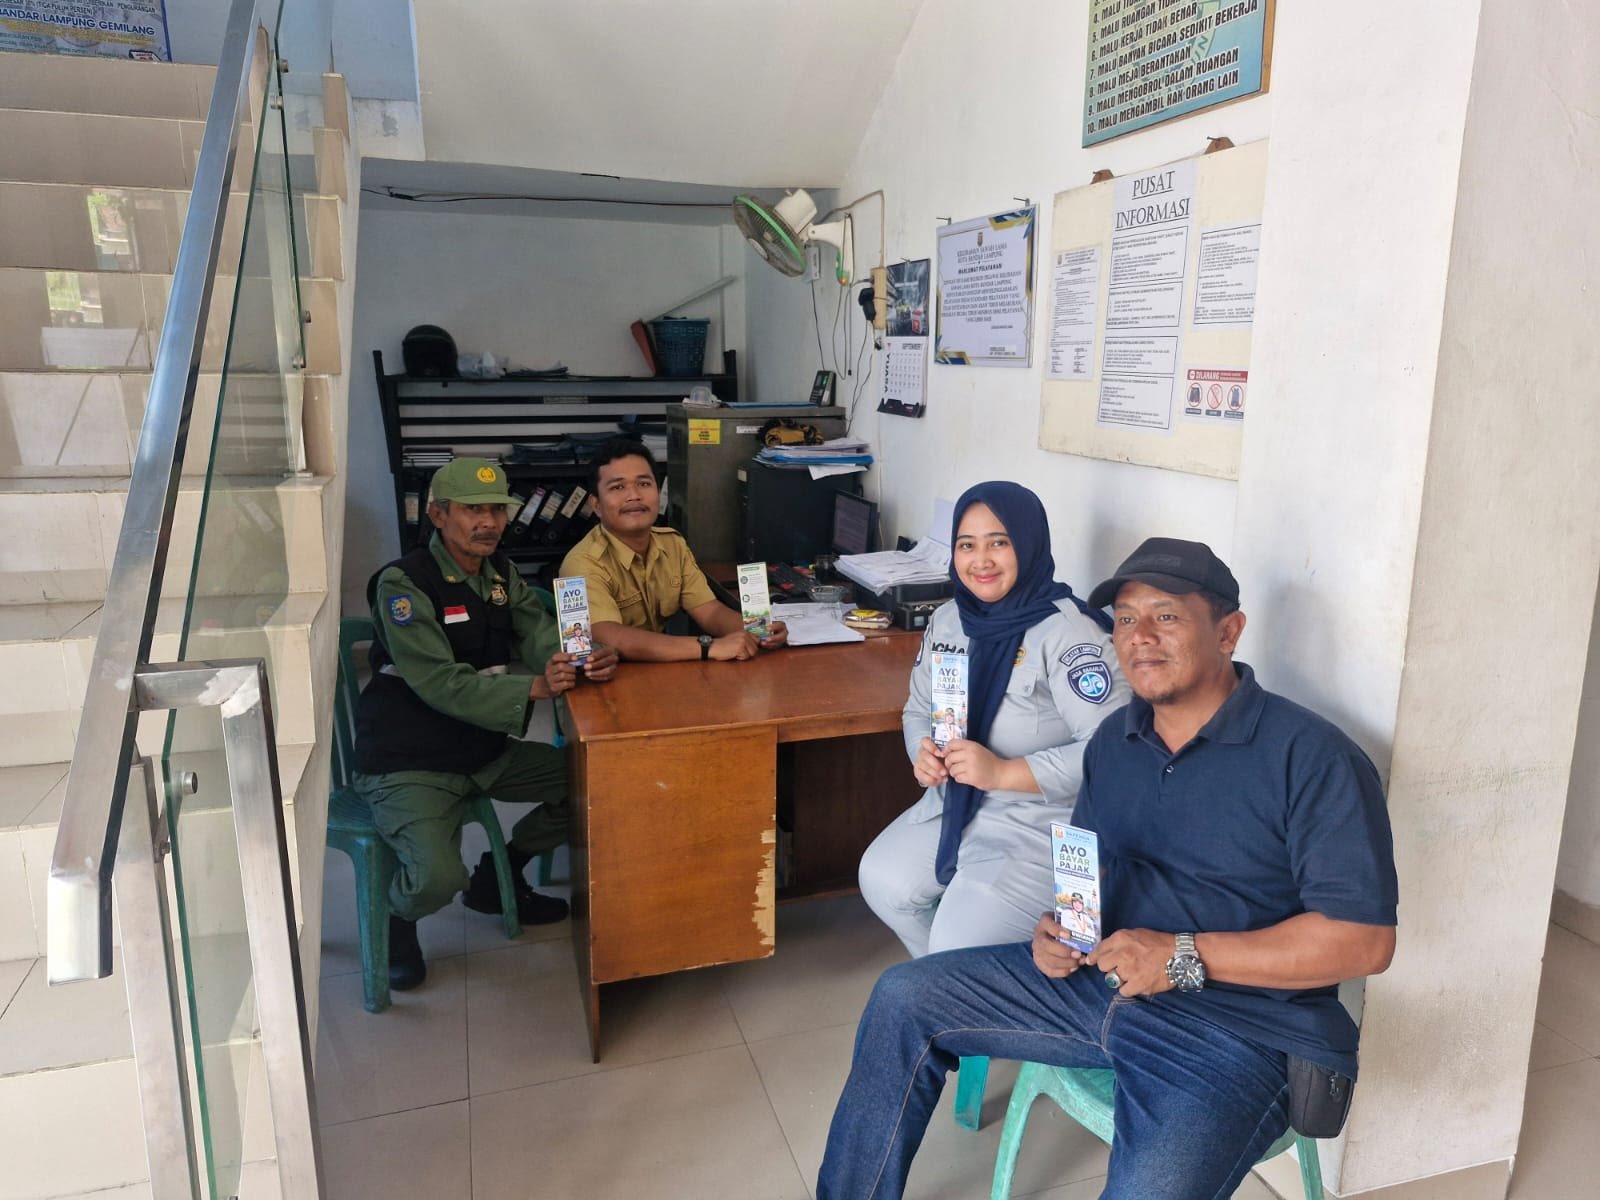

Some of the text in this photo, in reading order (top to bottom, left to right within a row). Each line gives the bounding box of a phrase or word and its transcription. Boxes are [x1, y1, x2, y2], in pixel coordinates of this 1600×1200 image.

[0, 9, 39, 21] ANDAR
[43, 13, 96, 28] LAMPUNG
[99, 20, 155, 36] GEMILANG
[1101, 19, 1120, 40] MALU
[1121, 1, 1156, 29] RUANGAN
[1102, 1, 1121, 21] MALU
[1097, 58, 1117, 77] MALU
[1119, 44, 1146, 67] BANYAK
[1148, 31, 1177, 55] BICARA
[1179, 15, 1213, 42] SEDIKIT
[1215, 0, 1258, 27] BEKERJA
[1099, 38, 1119, 58] MALU
[1121, 27, 1143, 48] KERJA
[1146, 15, 1168, 37] TIDAK
[1170, 2, 1198, 26] BENAR
[1096, 95, 1116, 113] MALU
[1118, 77, 1162, 105] MENGOBROL
[1164, 64, 1193, 87] DALAM
[1195, 47, 1239, 75] RUANGAN
[1097, 76, 1117, 95] MALU
[1118, 67, 1138, 86] MEJA
[1140, 46, 1191, 77] BERANTAKAN
[1098, 113, 1118, 130] MALU
[1119, 96, 1164, 122] MENGAMBIL
[1166, 89, 1183, 106] HAK
[1185, 77, 1215, 100] ORANG
[1217, 69, 1239, 89] LAIN
[1132, 170, 1176, 197] PUSAT
[1115, 197, 1191, 229] INFORMASI
[564, 589, 581, 598] AYO
[938, 667, 960, 677] AYO
[1059, 853, 1090, 866] BAYAR
[1060, 843, 1087, 858] AYO
[1059, 860, 1090, 875] PAJAK
